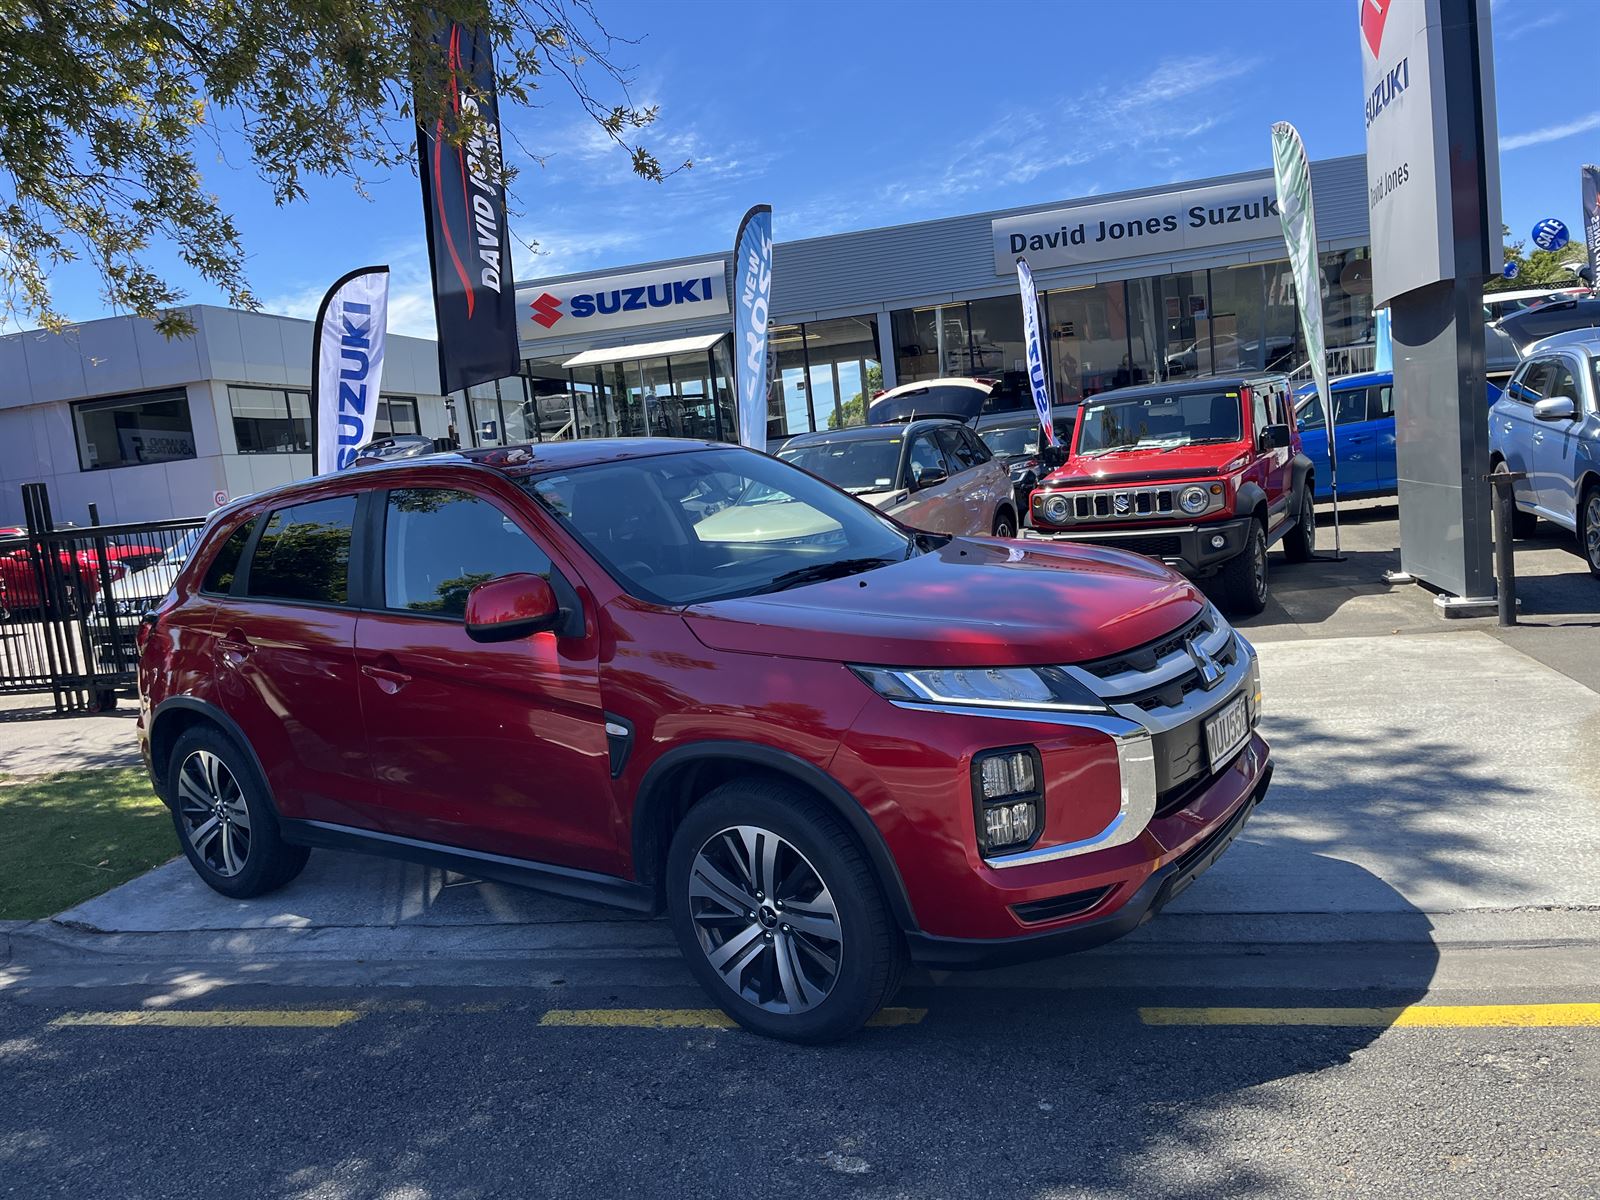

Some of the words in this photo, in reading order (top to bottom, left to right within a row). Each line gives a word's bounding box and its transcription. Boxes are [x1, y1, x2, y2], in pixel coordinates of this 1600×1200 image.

[1366, 57, 1410, 129] SUZUKI
[460, 92, 497, 196] JONS
[1384, 162, 1409, 197] Jones
[473, 195, 501, 293] DAVID
[1010, 223, 1085, 254] David
[1095, 213, 1178, 243] Jones
[1188, 196, 1280, 228] Suzuk
[1536, 219, 1564, 248] SALE
[570, 277, 713, 318] SUZUKI
[742, 248, 760, 309] NEW
[337, 301, 372, 471] SUZUKI
